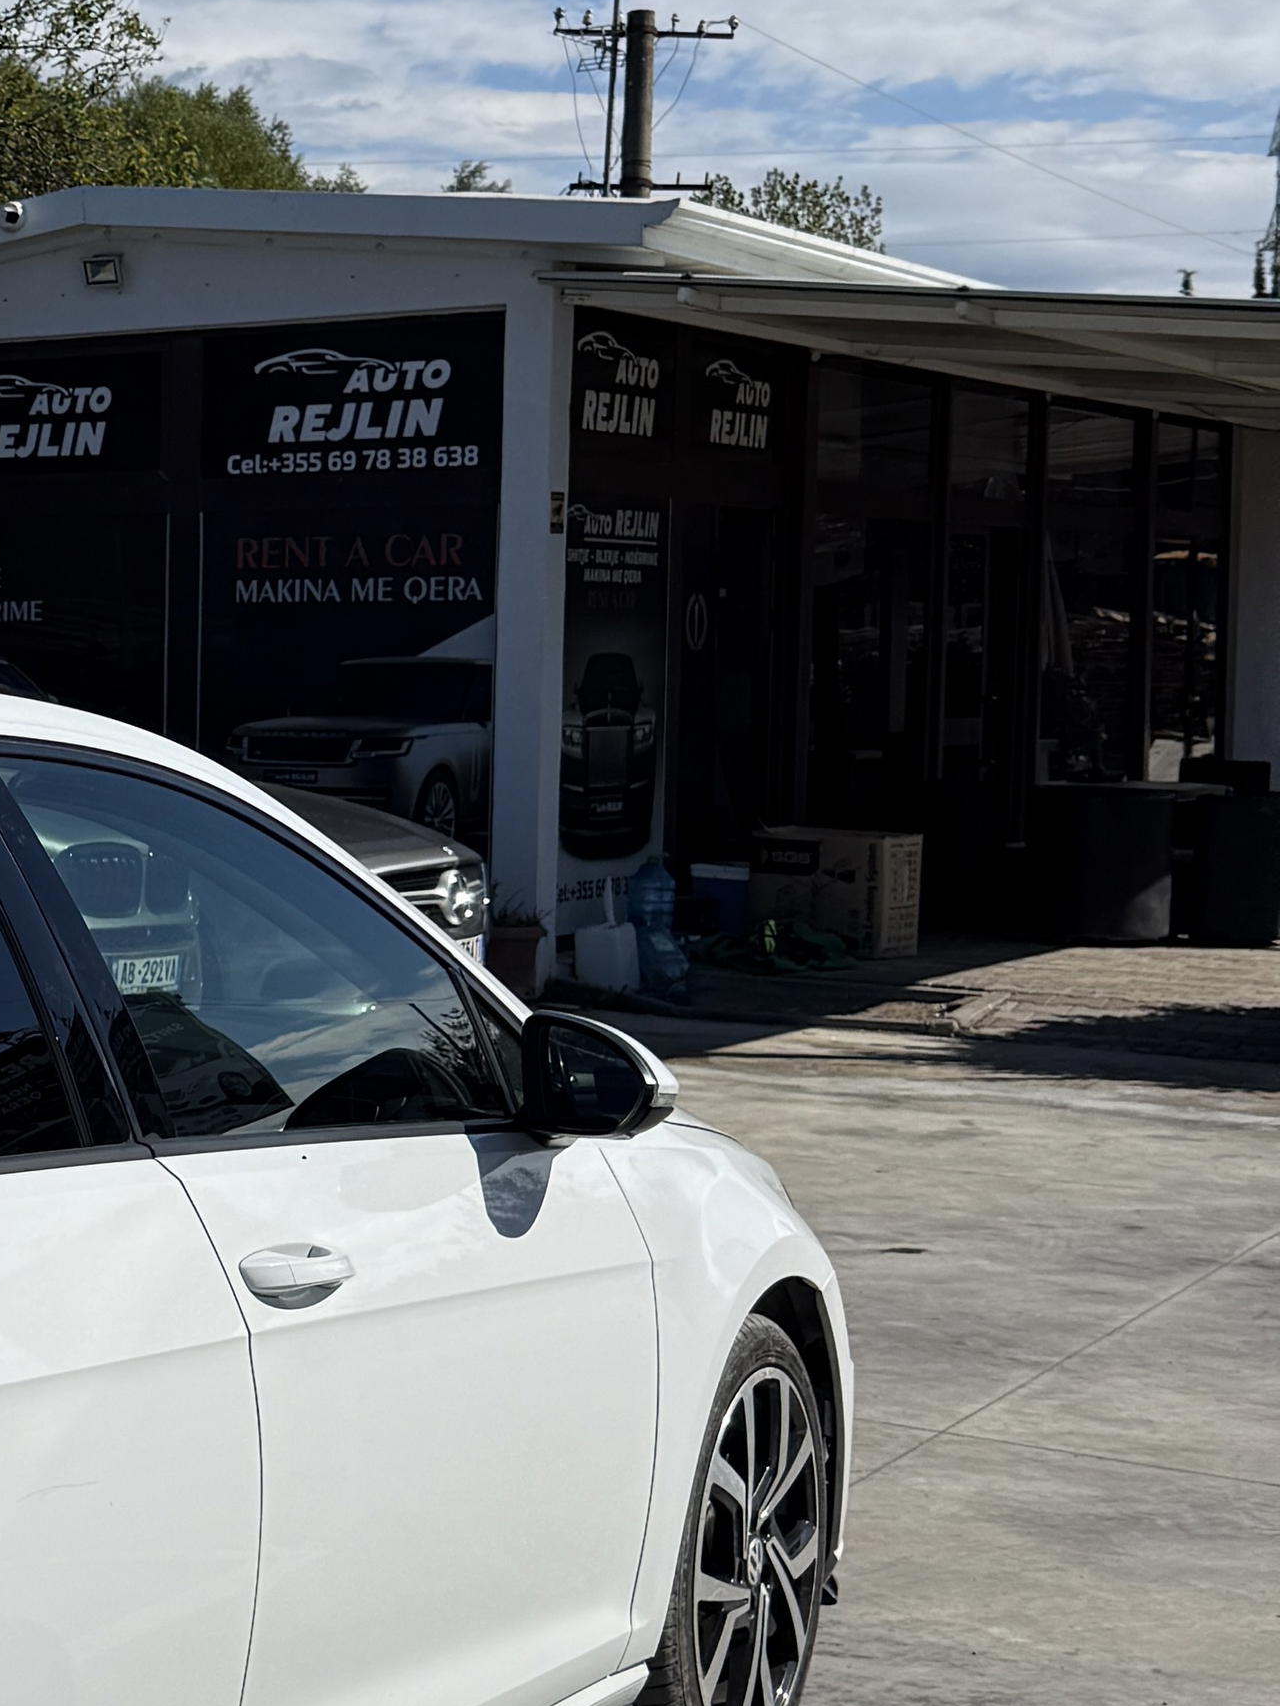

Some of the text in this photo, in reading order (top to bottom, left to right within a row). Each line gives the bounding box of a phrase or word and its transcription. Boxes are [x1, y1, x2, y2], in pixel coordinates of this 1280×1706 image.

[343, 359, 452, 393] AUTO
[615, 357, 660, 389] AUTO
[28, 386, 113, 416] AUTO
[736, 381, 771, 408] AUTO
[267, 397, 444, 443] REJLIN
[581, 389, 656, 437] REJLIN
[709, 409, 768, 449] REJLIN
[227, 445, 480, 475] Cel:+355 69 78 38 638
[614, 509, 661, 539] REJLIN
[236, 533, 463, 569] RENT A CAR
[235, 575, 483, 604] MAKINA ME QERA
[120, 960, 136, 986] AB
